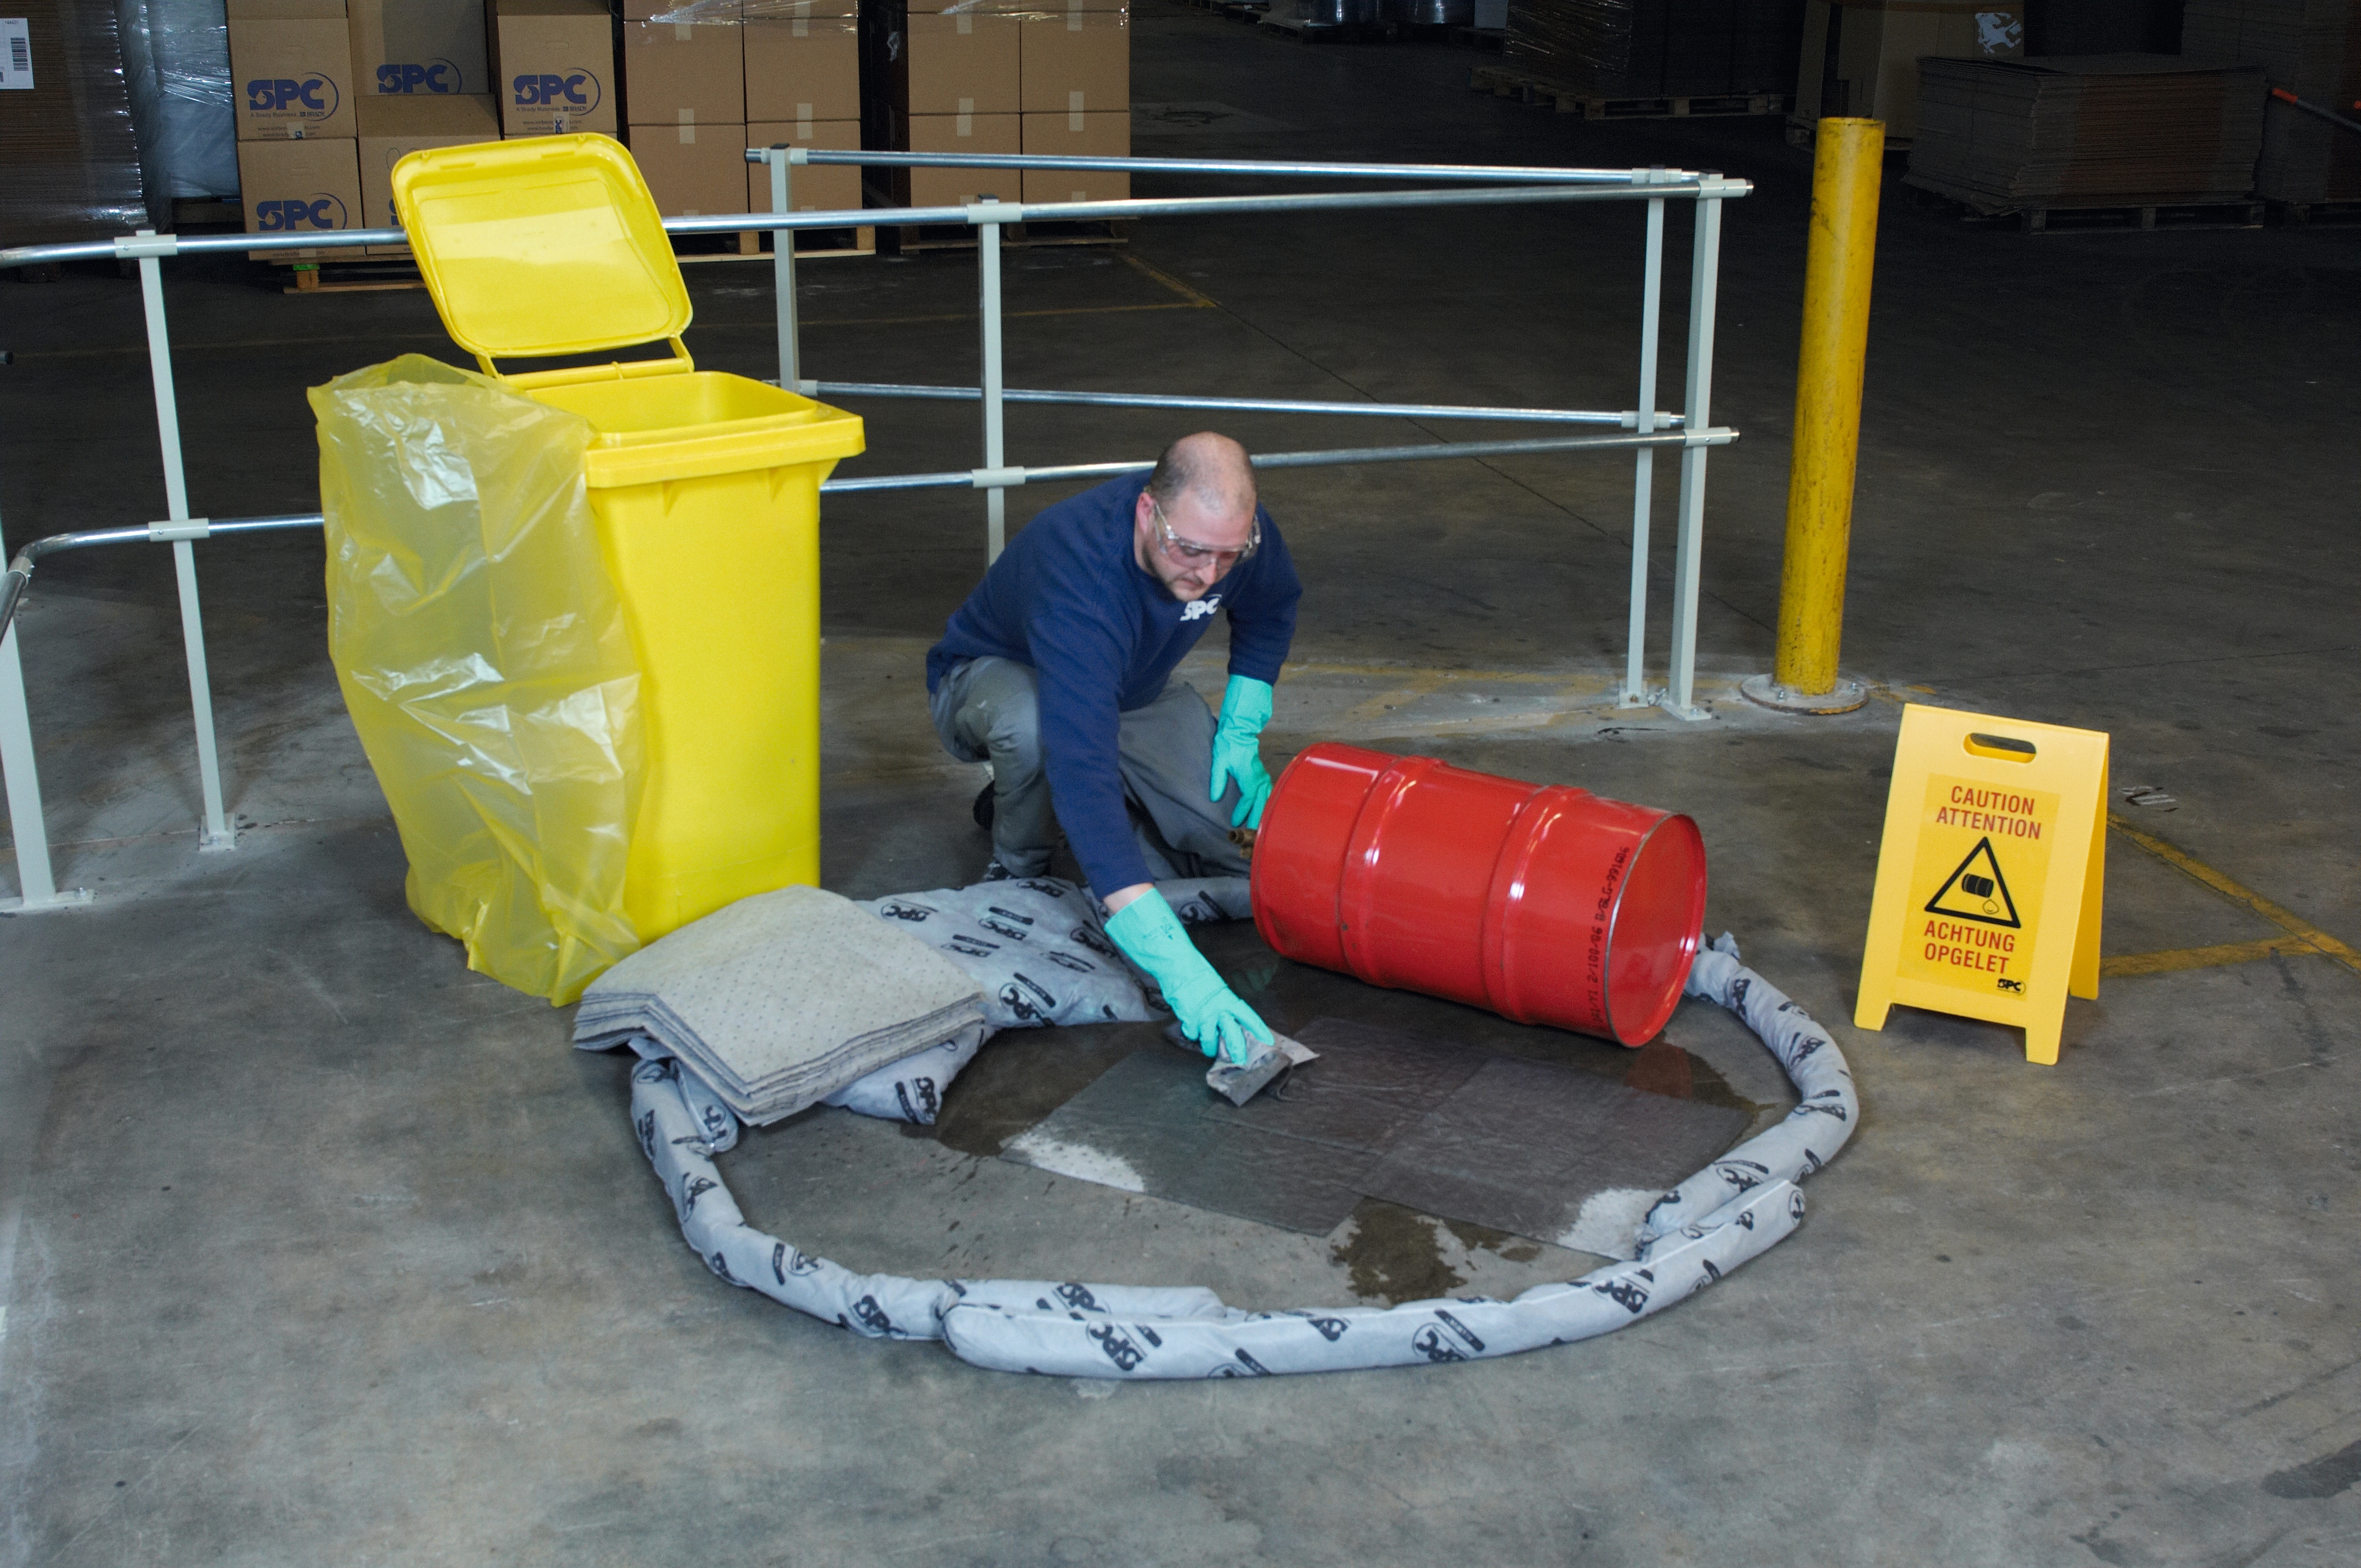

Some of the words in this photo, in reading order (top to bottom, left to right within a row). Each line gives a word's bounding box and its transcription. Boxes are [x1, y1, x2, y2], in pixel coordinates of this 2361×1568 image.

[377, 64, 448, 94] SPC
[513, 74, 587, 105] SPC
[247, 79, 325, 110] SPC
[256, 199, 333, 231] SPC
[1179, 597, 1220, 622] SPC
[1951, 786, 2034, 815] CAUTION
[1936, 807, 2041, 840] ATTENTION
[884, 905, 931, 922] SPC
[981, 921, 1027, 940] SPC
[1924, 920, 2015, 952] ACHTUNG
[1925, 943, 2009, 973] OPGELET
[1997, 978, 2022, 992] SPC
[1090, 1324, 1144, 1371] SPC
